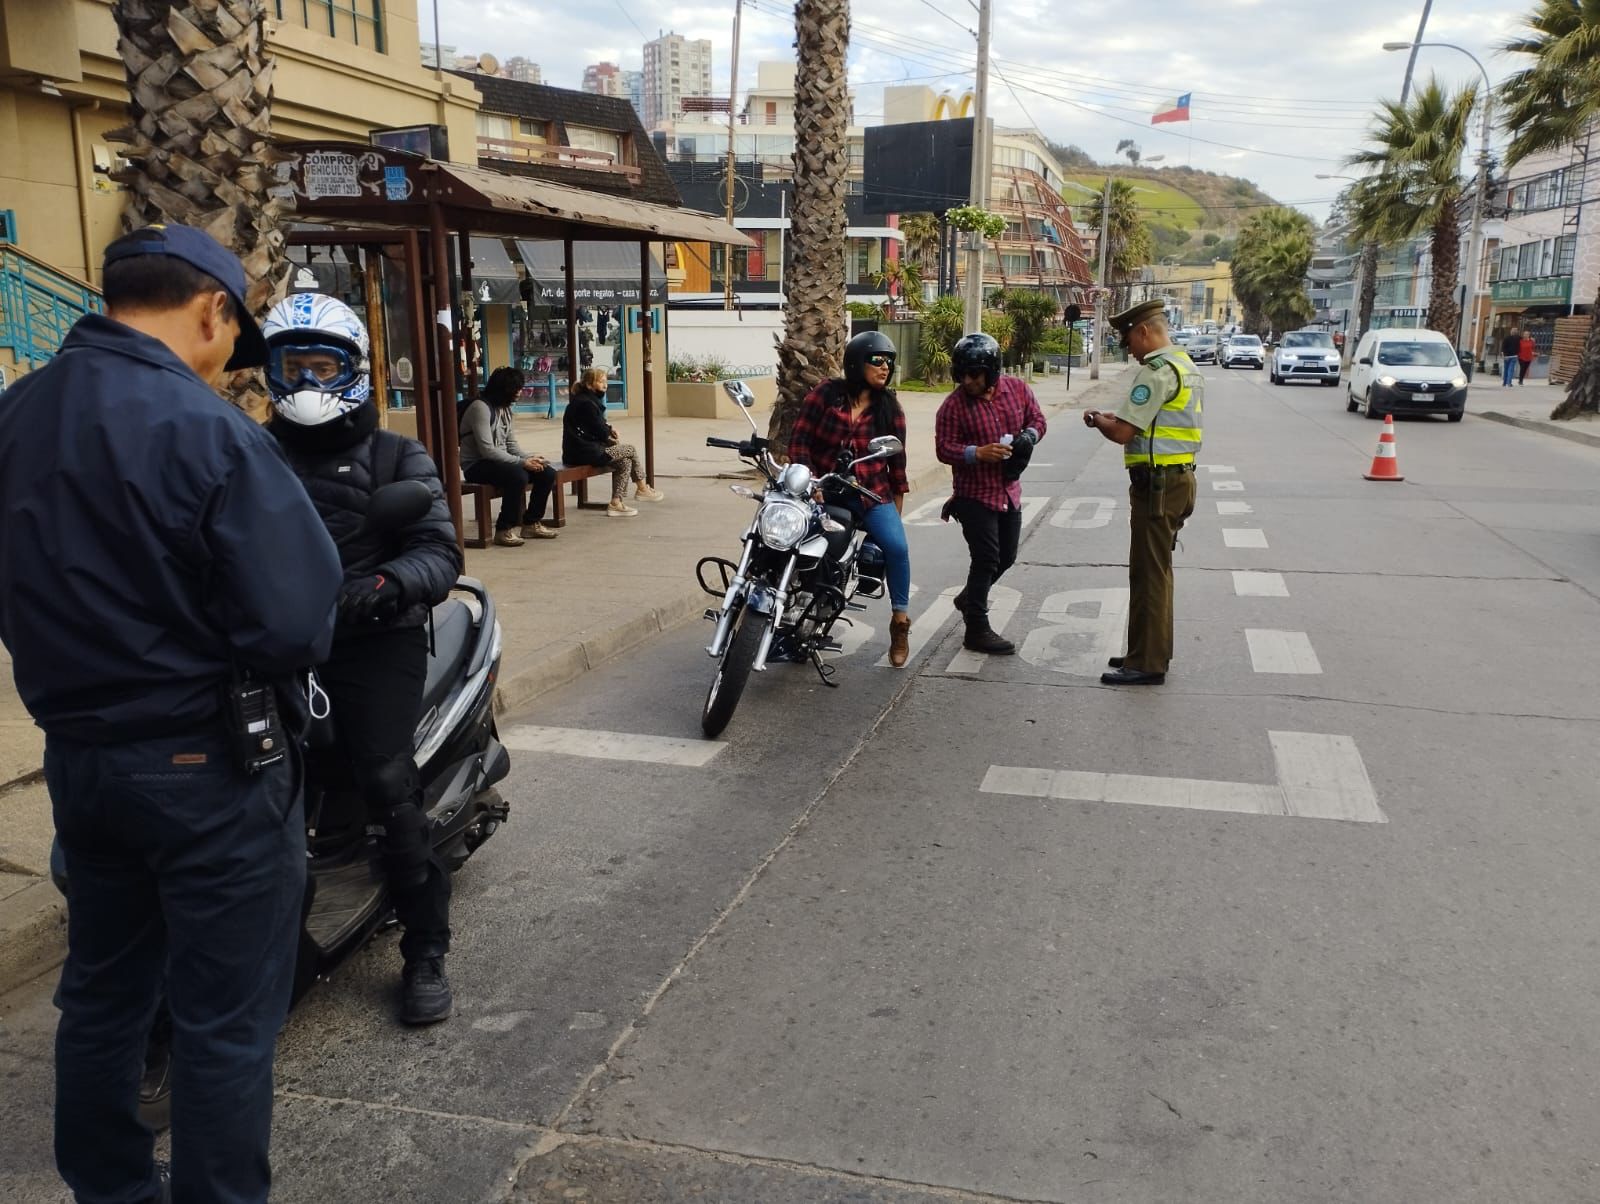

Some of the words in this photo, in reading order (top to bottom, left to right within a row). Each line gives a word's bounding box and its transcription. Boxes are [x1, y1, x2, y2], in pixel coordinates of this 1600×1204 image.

[305, 155, 354, 165] COMPRO
[305, 165, 354, 176] VEHICULOS
[541, 288, 554, 297] Art.
[556, 288, 565, 298] de
[593, 289, 615, 300] regalos
